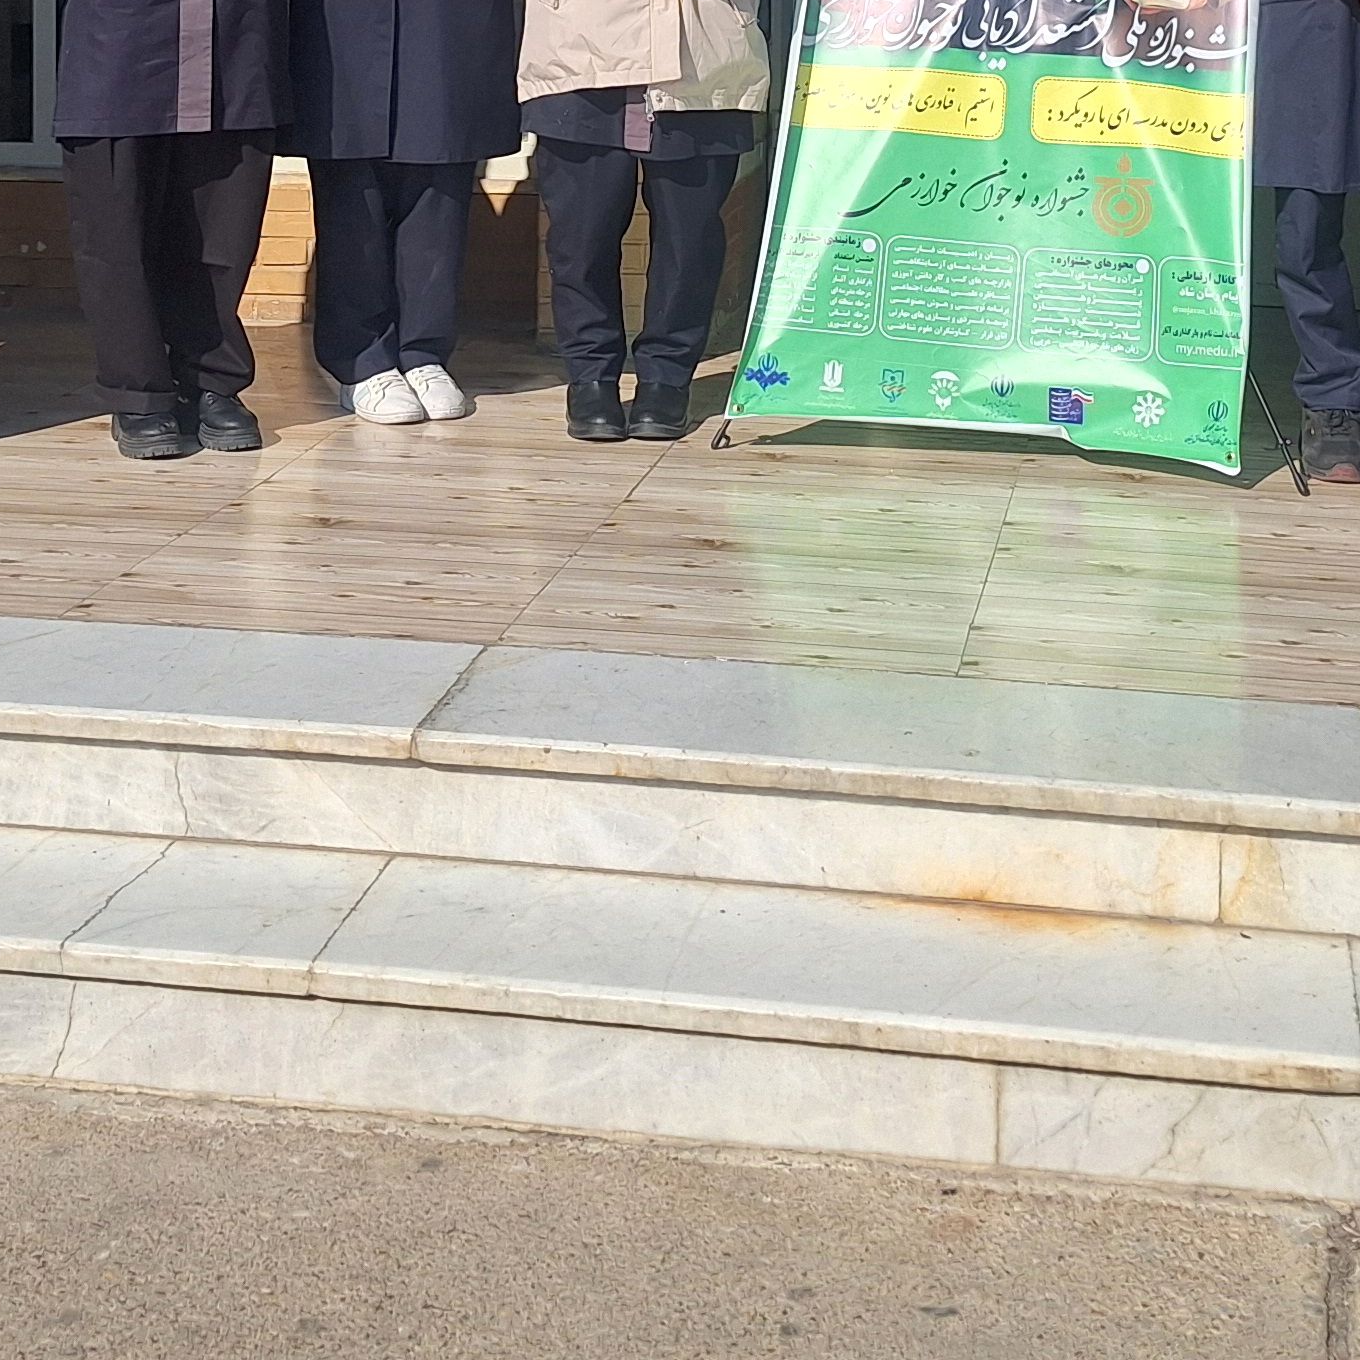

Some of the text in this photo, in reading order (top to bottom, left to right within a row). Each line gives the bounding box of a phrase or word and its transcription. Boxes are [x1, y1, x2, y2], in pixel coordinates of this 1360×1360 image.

[1102, 3, 1146, 68] ملی
[1140, 16, 1248, 73] شنواره
[915, 86, 955, 113] فناوری
[1099, 105, 1106, 136] با
[1107, 107, 1131, 130] ای
[1169, 117, 1209, 136] درون
[837, 167, 958, 218] خوارزمی
[1030, 167, 1090, 217] جشنواره
[1094, 257, 1134, 272] محورهای
[1212, 273, 1237, 285] کانال
